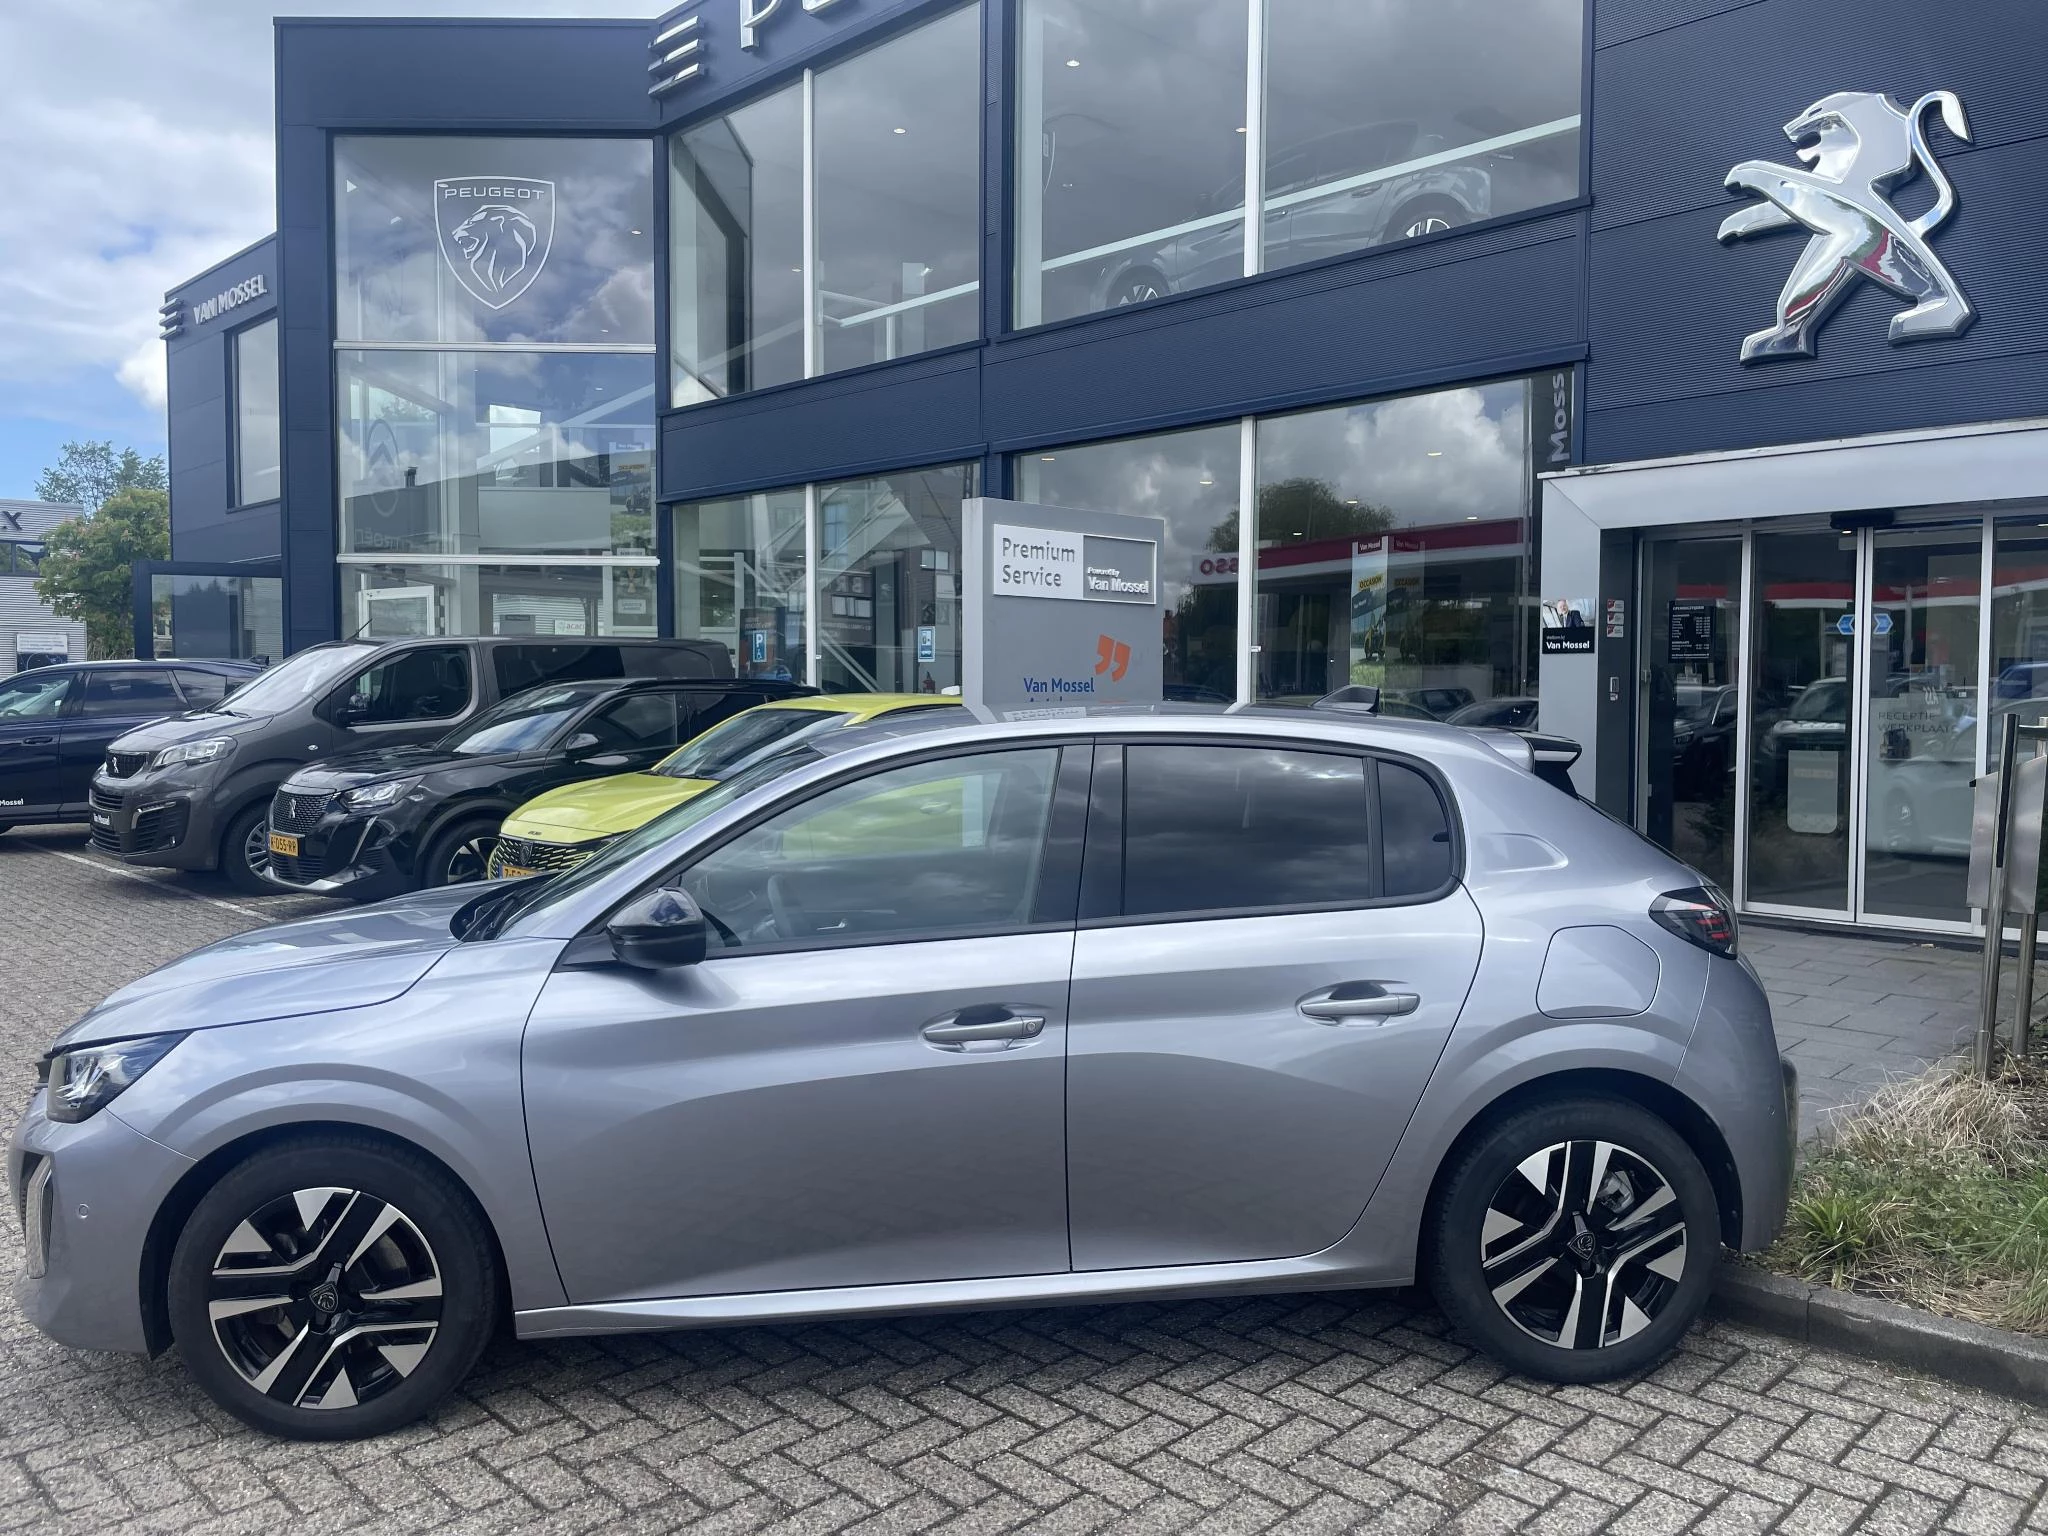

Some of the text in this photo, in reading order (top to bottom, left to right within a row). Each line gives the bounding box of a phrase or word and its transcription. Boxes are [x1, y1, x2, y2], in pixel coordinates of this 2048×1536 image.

[444, 187, 545, 200] PEUGEOT
[193, 274, 268, 325] VAN MOSSEL
[1002, 537, 1075, 563] Premium
[1002, 564, 1062, 587] Service
[1088, 576, 1149, 594] Van Mossel
[1546, 640, 1590, 650] Van Mossel
[1024, 677, 1095, 693] Van Mossel
